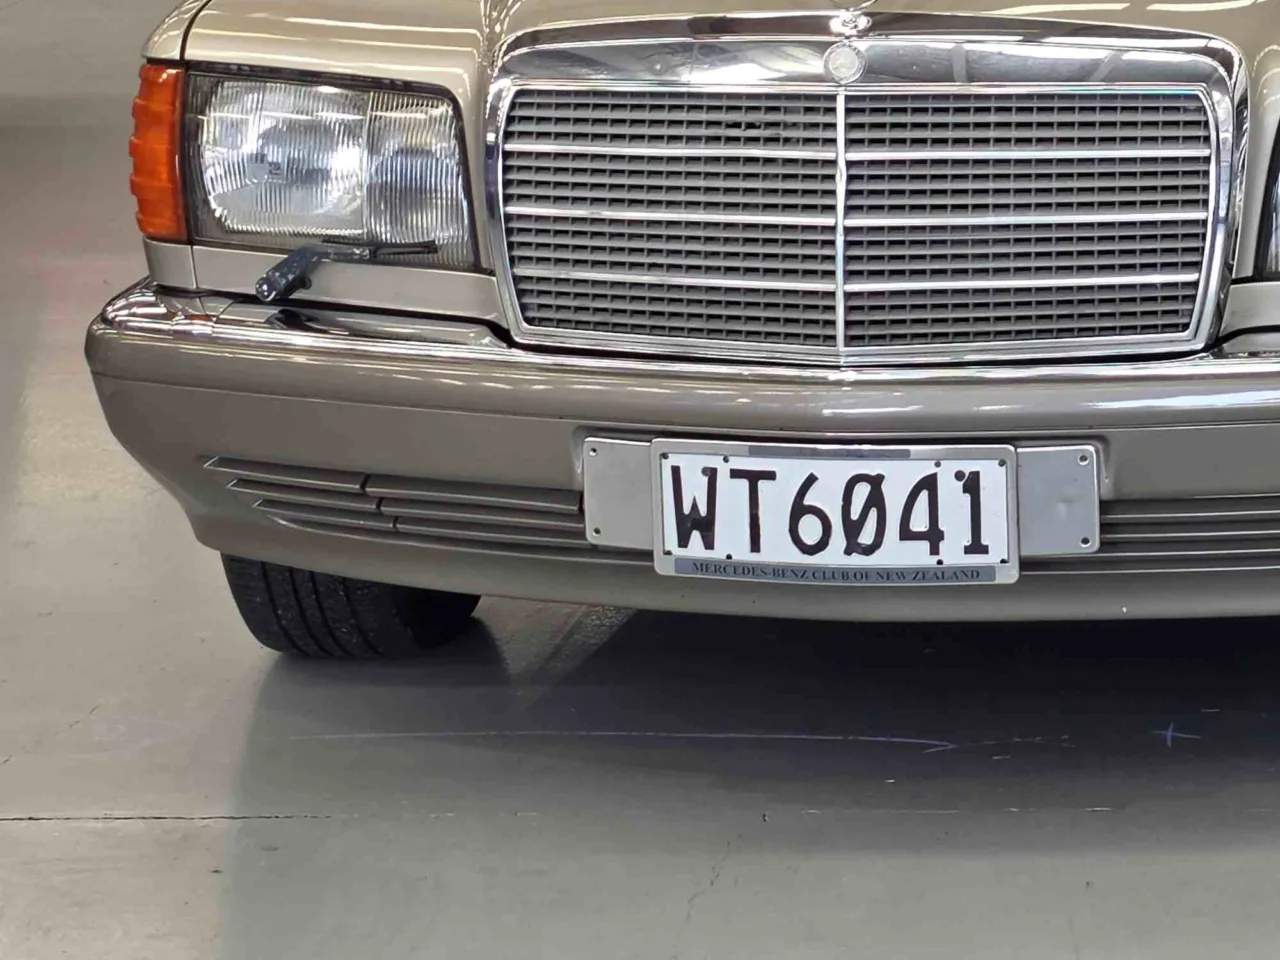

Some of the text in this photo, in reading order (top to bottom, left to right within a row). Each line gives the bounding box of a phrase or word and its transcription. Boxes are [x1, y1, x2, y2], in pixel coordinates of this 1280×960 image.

[669, 464, 990, 557] WT6041
[691, 561, 981, 582] MERCEDES-BENZ CLUB OF NEW ZEALAND
